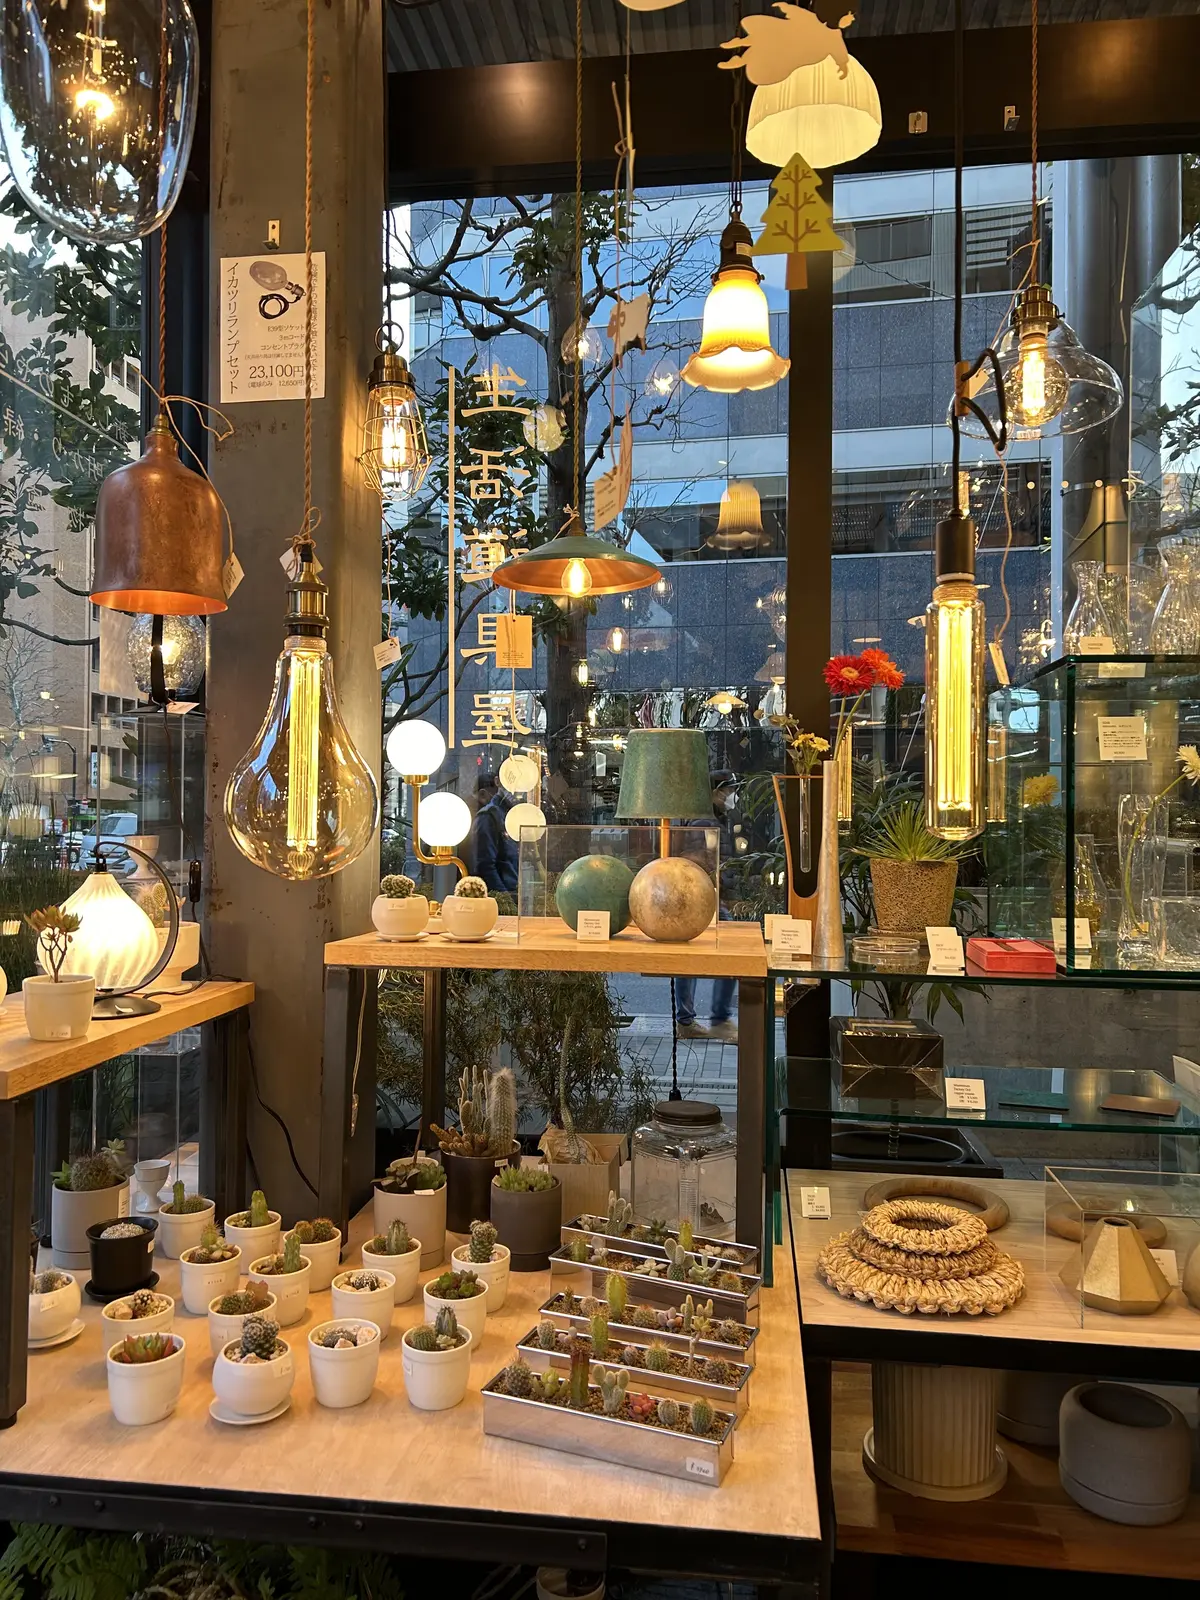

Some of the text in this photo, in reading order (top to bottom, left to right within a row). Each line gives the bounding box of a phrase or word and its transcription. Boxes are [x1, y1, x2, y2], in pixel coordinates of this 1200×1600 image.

[227, 262, 240, 395] イカツリランプセット
[249, 363, 305, 379] 23,100円
